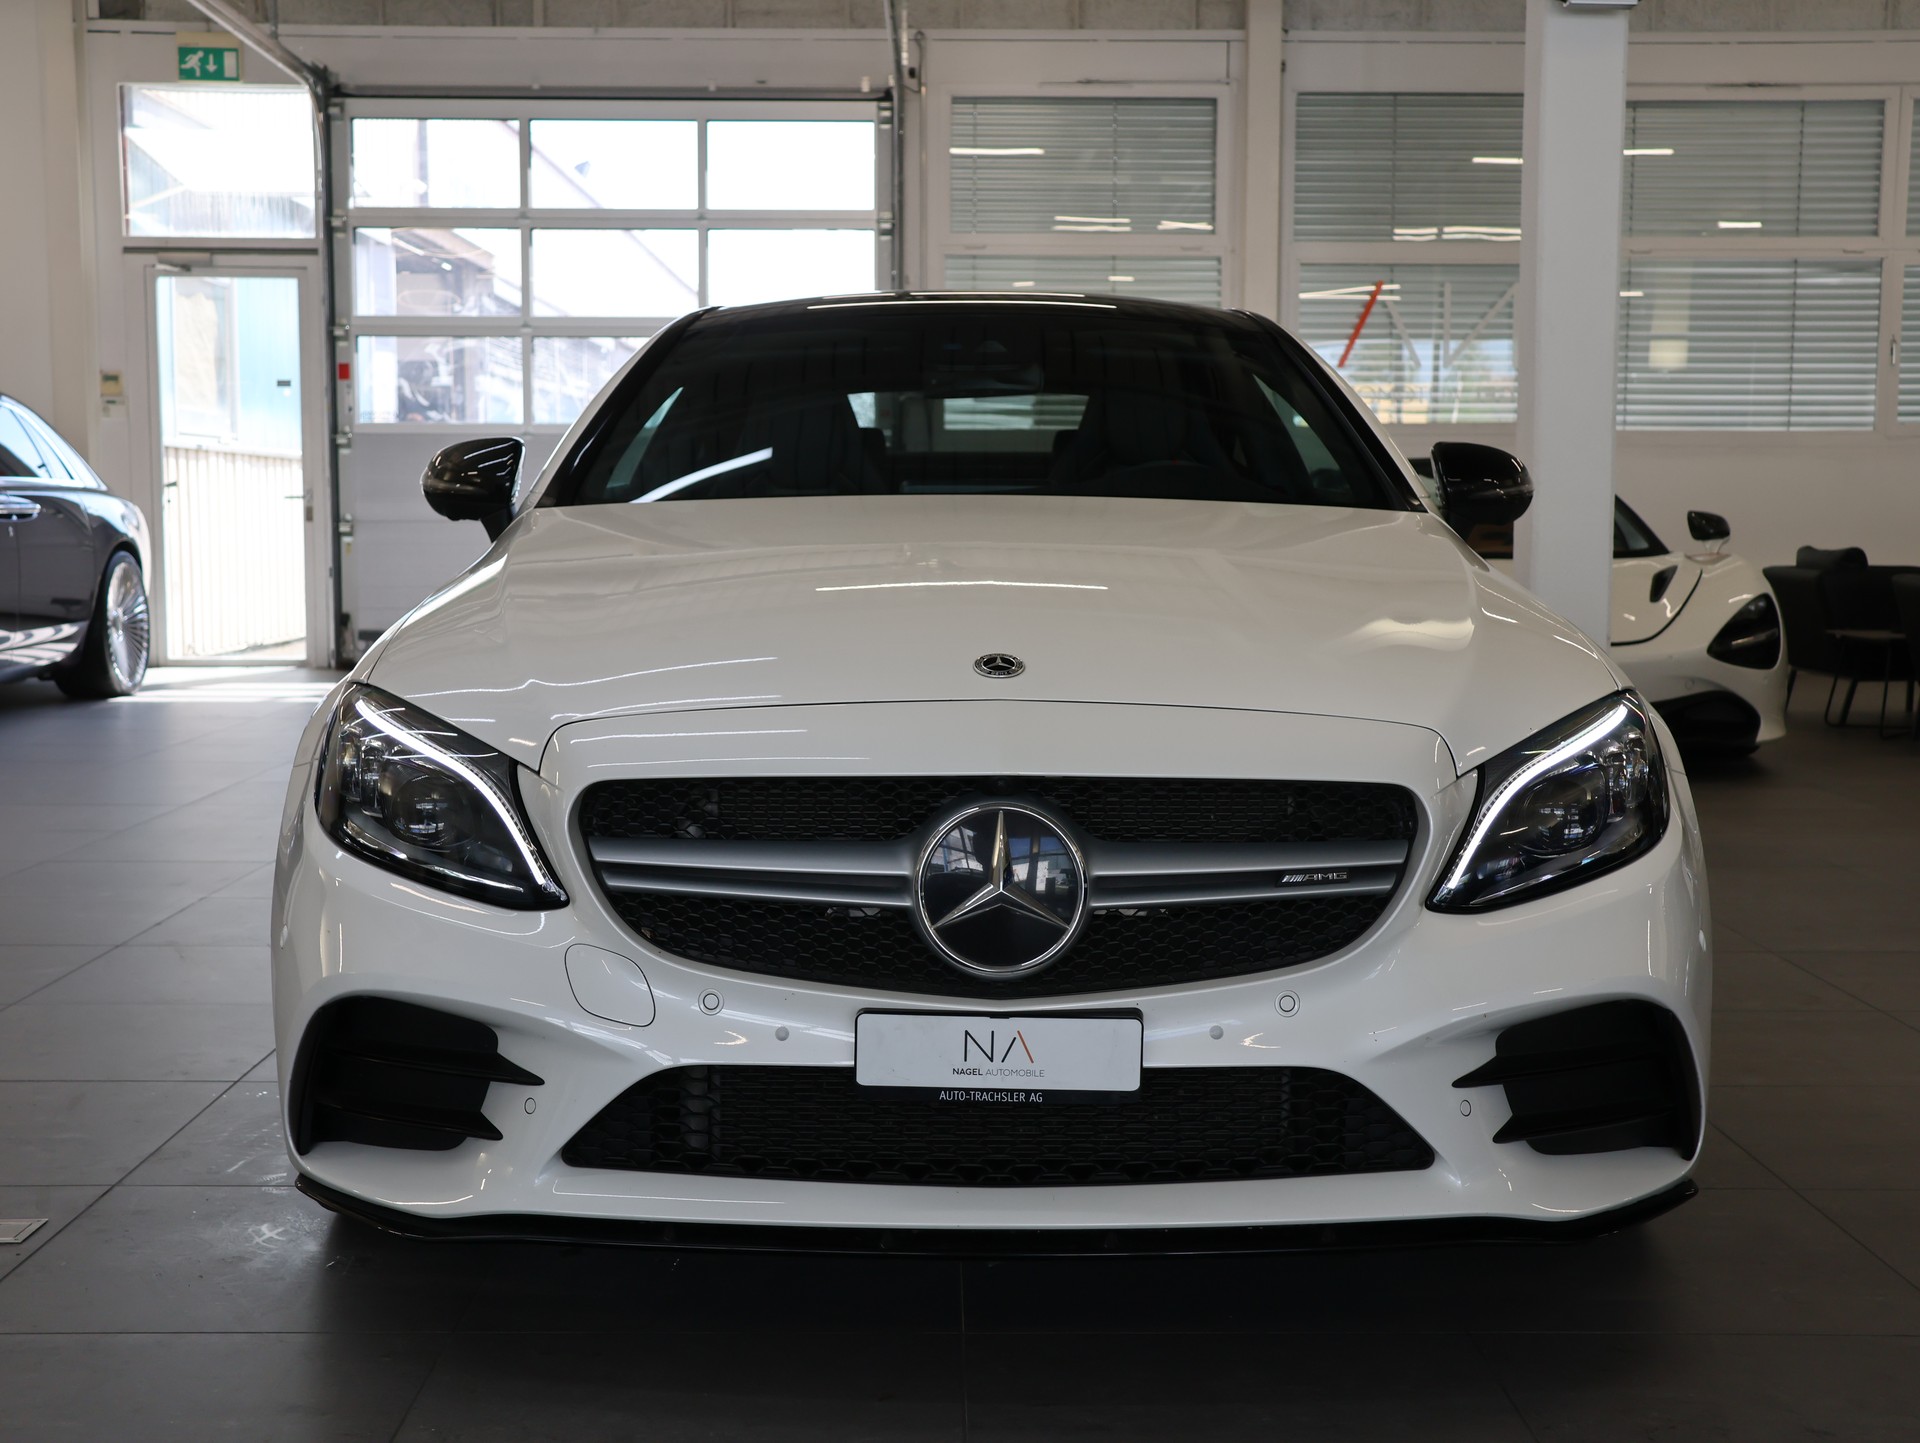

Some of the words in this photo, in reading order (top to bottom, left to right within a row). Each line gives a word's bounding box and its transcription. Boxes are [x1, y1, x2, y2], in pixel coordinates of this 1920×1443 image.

[1302, 871, 1348, 882] AMG
[964, 1029, 1034, 1063] NA
[952, 1068, 983, 1076] NAGEL
[985, 1068, 1045, 1077] AUTOMOBILE
[939, 1090, 1026, 1102] AUTO-TRACHSLER
[1029, 1092, 1043, 1103] AG
